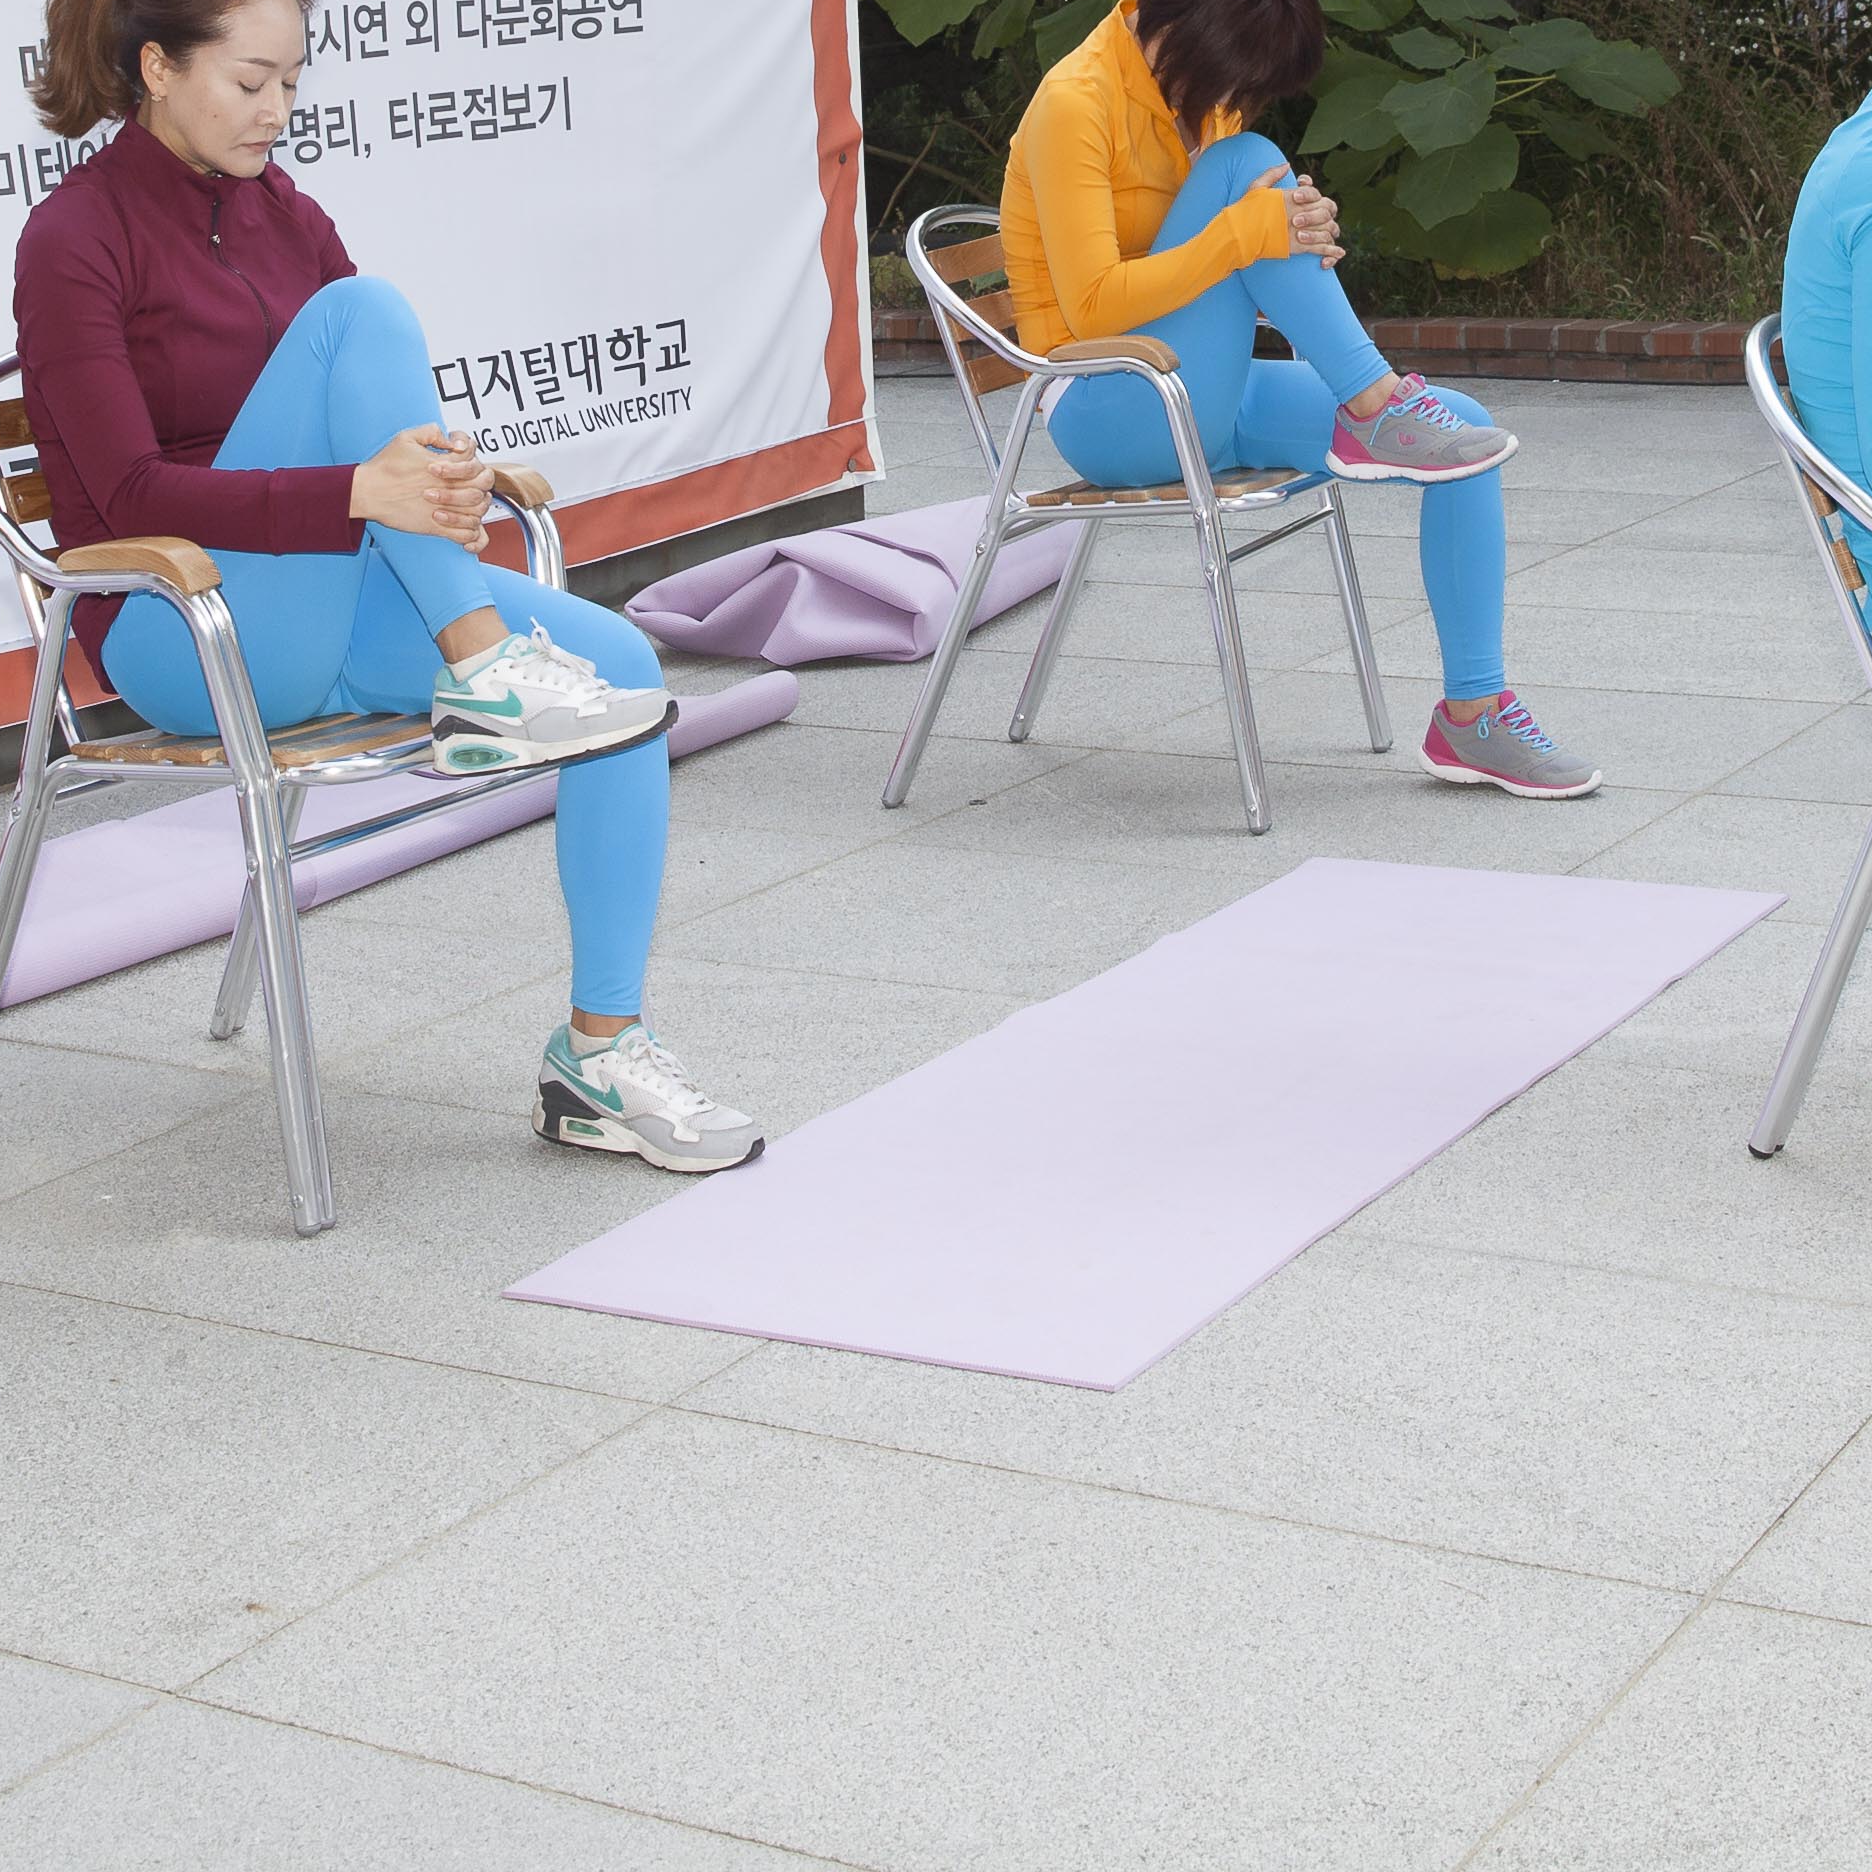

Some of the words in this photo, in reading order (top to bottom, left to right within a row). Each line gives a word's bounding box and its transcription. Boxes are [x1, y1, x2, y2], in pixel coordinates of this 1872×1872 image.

[387, 76, 573, 150] 타로점보기
[500, 413, 581, 450] DIGITAL
[578, 385, 692, 433] UNIVERSITY
